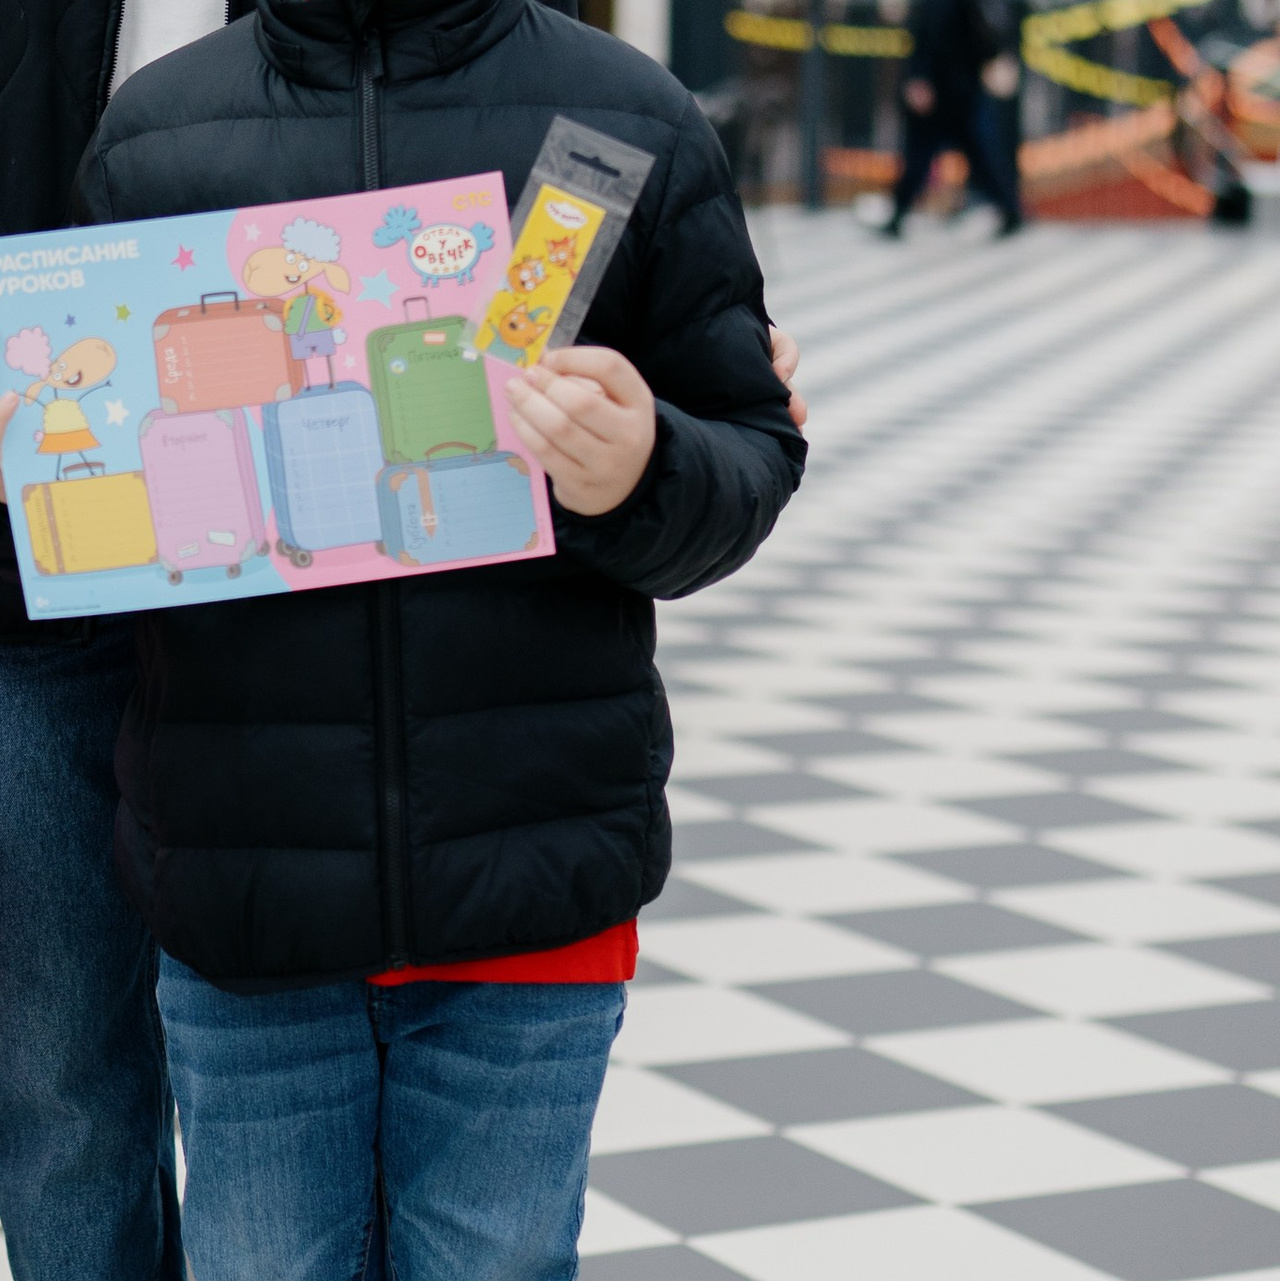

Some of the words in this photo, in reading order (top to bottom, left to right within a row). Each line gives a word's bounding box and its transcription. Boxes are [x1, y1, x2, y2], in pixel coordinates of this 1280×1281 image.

[452, 191, 493, 211] СТС
[423, 228, 461, 241] ОТЕЛЬ
[414, 239, 473, 264] ОВЕЧЕК
[439, 239, 447, 250] У
